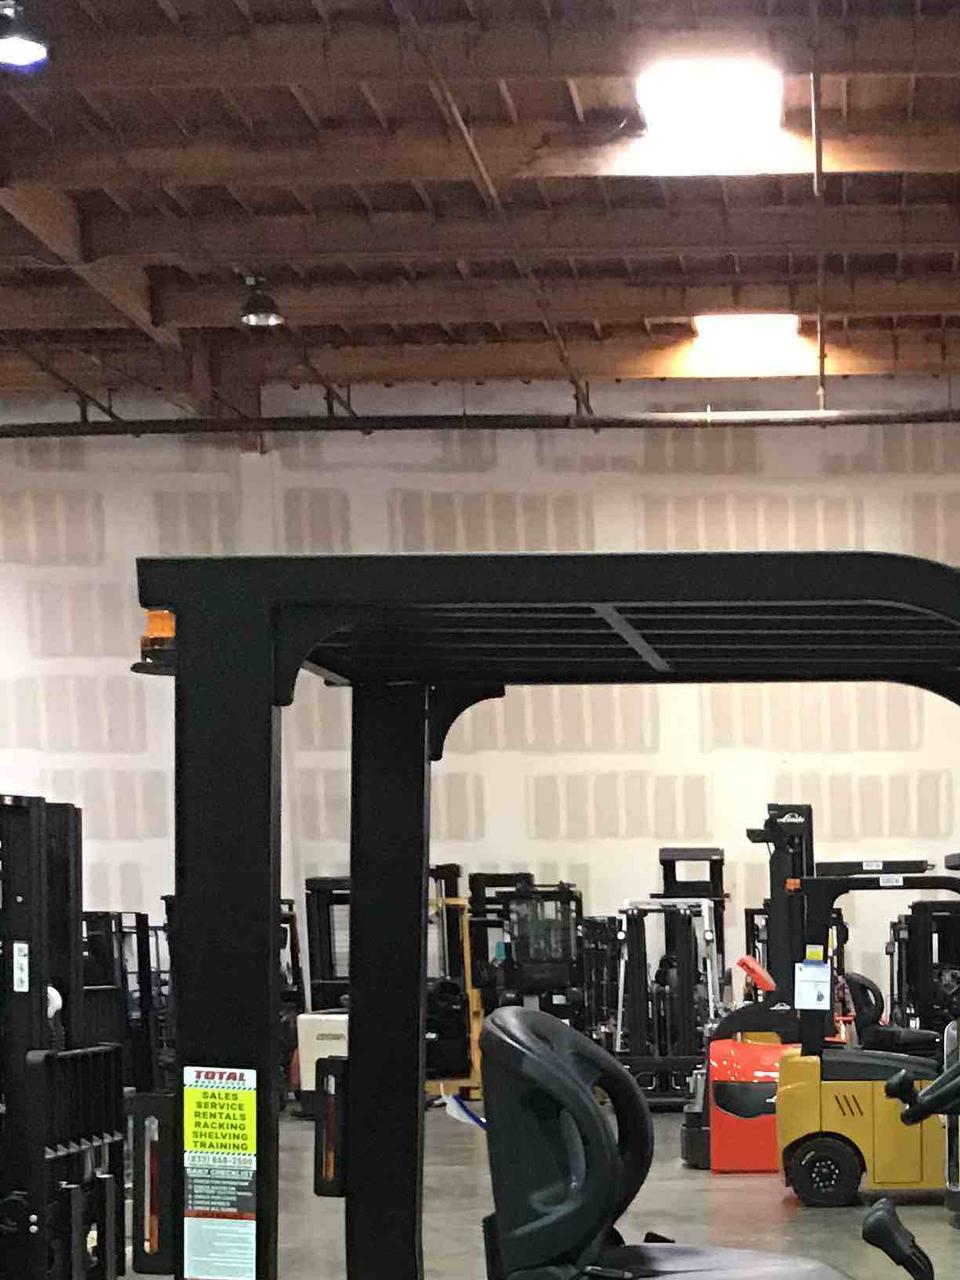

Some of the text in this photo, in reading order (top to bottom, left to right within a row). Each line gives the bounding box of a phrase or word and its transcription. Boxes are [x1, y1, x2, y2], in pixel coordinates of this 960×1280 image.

[194, 1070, 246, 1081] TOTAL
[202, 1091, 238, 1101] SALES
[196, 1101, 245, 1111] SERVICE
[194, 1111, 246, 1121] RENTALS
[194, 1121, 246, 1131] RACKING
[192, 1130, 249, 1141] SHELVING
[192, 1140, 249, 1151] TRAINING
